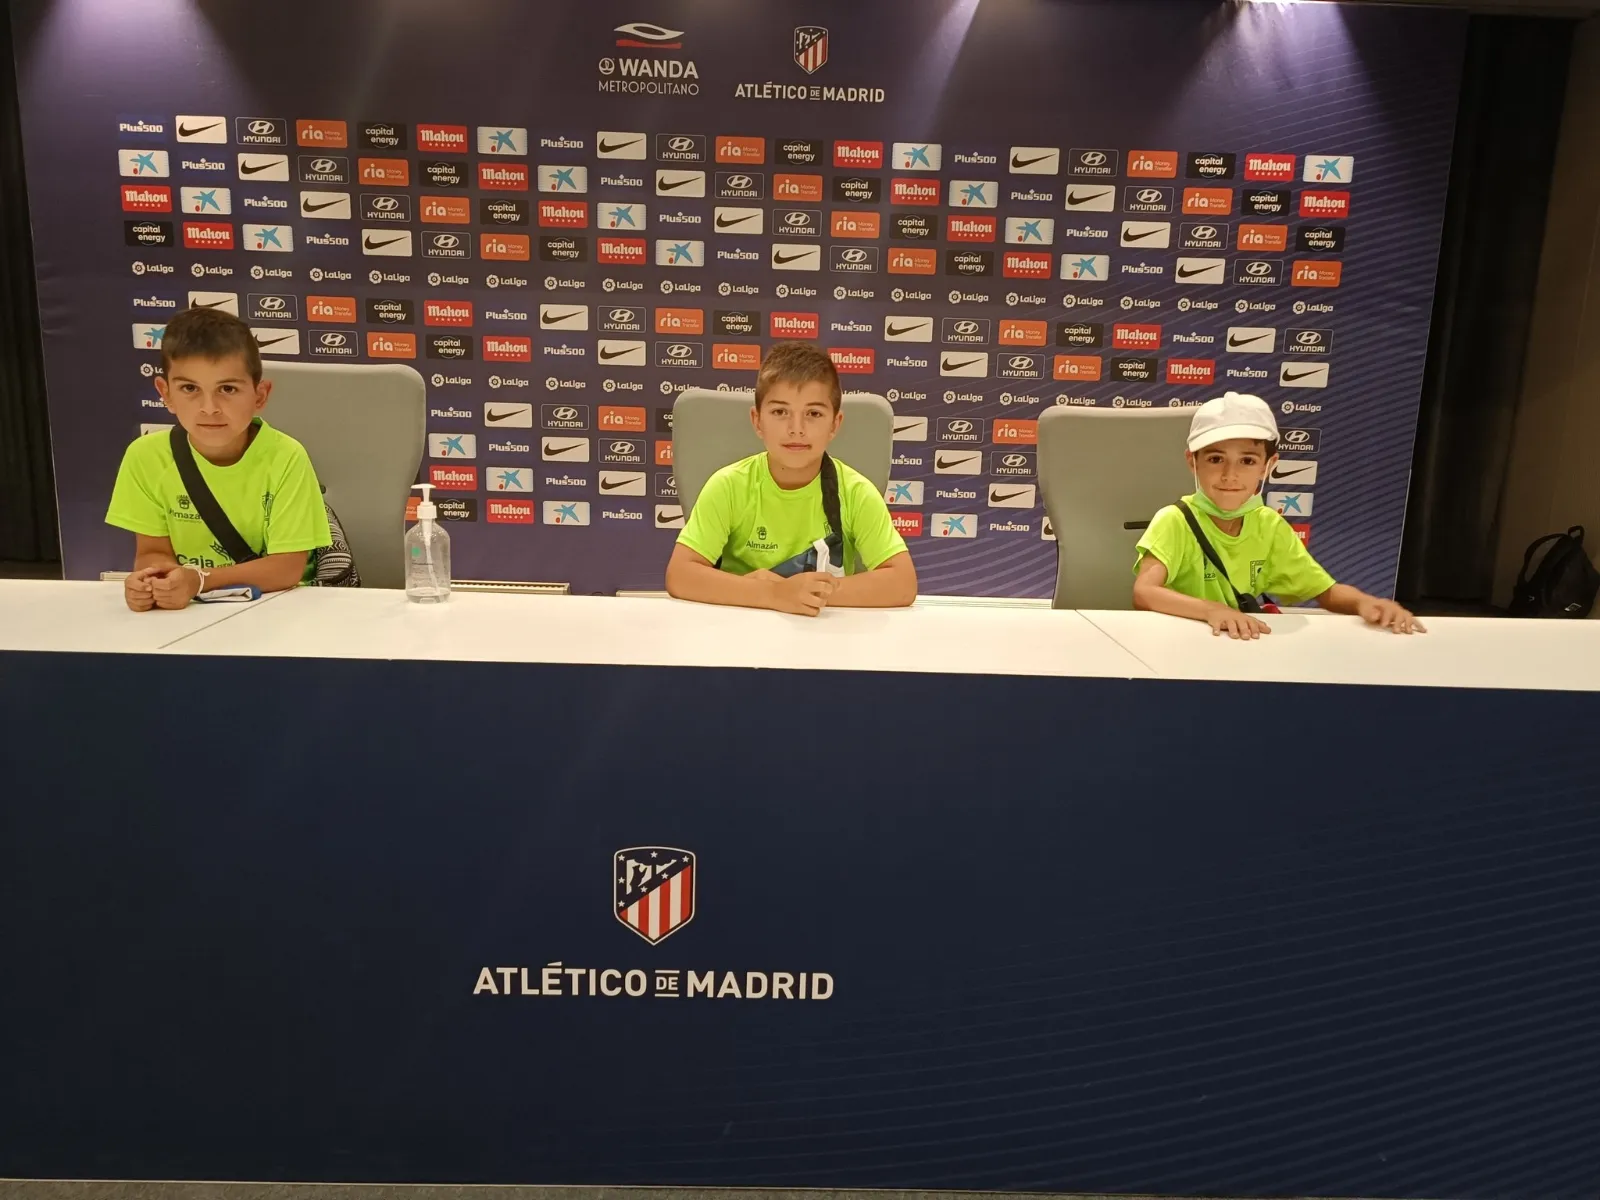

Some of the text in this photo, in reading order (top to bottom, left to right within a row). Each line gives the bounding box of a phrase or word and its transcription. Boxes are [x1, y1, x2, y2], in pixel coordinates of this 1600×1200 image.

[619, 58, 699, 79] WANDA
[598, 80, 699, 96] METROPOLITANO
[735, 81, 807, 100] ATLÉTICO
[823, 87, 885, 103] MADRID
[120, 121, 163, 132] Plus500
[366, 128, 393, 136] capital
[302, 125, 323, 140] ria
[421, 130, 463, 142] Mahou
[371, 137, 398, 145] energy
[541, 136, 583, 148] Plus500
[721, 142, 741, 156] ria
[783, 144, 810, 152] capital
[838, 146, 879, 158] Mahou
[955, 152, 996, 163] Plus500
[1133, 156, 1153, 170] ria
[1195, 157, 1223, 166] capital
[182, 158, 225, 170] Plus500
[1249, 159, 1290, 171] Mahou
[364, 164, 385, 178] ria
[427, 166, 455, 174] capital
[482, 168, 524, 180] Mahou
[1199, 167, 1226, 175] energy
[779, 179, 799, 193] ria
[125, 191, 168, 202] Mahou
[1011, 189, 1052, 201] Plus500
[1188, 193, 1208, 207] ria
[1250, 195, 1278, 203] capital
[244, 196, 287, 207] Plus500
[1304, 196, 1345, 208] Mahou
[426, 202, 446, 216] ria
[488, 204, 515, 212] capital
[542, 206, 584, 218] Mahou
[493, 213, 520, 221] energy
[660, 212, 701, 223] Plus500
[836, 217, 856, 230] ria
[898, 219, 925, 227] capital
[951, 221, 992, 232] Mahou
[133, 226, 160, 234] capital
[187, 228, 230, 239] Mahou
[902, 224, 929, 235] energy
[1067, 226, 1108, 237] Plus500
[1305, 231, 1332, 239] capital
[306, 234, 348, 245] Plus500
[1243, 230, 1263, 243] ria
[486, 239, 506, 253] ria
[548, 241, 574, 249] capital
[1309, 240, 1335, 248] energy
[553, 250, 579, 258] energy
[718, 248, 759, 259] Plus500
[893, 253, 913, 267] ria
[1007, 257, 1047, 269] Mahou
[147, 264, 173, 273] LaLiga
[1122, 262, 1163, 273] Plus500
[1297, 266, 1317, 279] ria
[265, 269, 292, 278] LaLiga
[384, 273, 410, 282] LaLiga
[501, 278, 527, 287] LaLiga
[617, 281, 643, 290] LaLiga
[733, 285, 758, 294] LaLiga
[848, 289, 874, 298] LaLiga
[963, 293, 988, 302] LaLiga
[1078, 297, 1103, 306] LaLiga
[312, 303, 333, 315] ria
[374, 304, 401, 312] capital
[1192, 301, 1218, 310] LaLiga
[1307, 304, 1333, 313] LaLiga
[428, 306, 469, 317] Mahou
[486, 309, 527, 320] Plus500
[661, 313, 680, 327] ria
[722, 315, 748, 323] capital
[774, 317, 814, 328] Mahou
[831, 321, 872, 331] Plus500
[1065, 327, 1091, 335] capital
[1004, 326, 1023, 338] ria
[1117, 329, 1156, 340] Mahou
[1173, 332, 1214, 343] Plus500
[372, 339, 393, 352] ria
[434, 339, 460, 347] capital
[487, 341, 527, 352] Mahou
[544, 344, 585, 355] Plus500
[718, 349, 737, 362] ria
[887, 356, 927, 367] Plus500
[1059, 360, 1078, 373] ria
[1119, 362, 1145, 370] capital
[1123, 369, 1149, 378] energy
[1171, 364, 1210, 375] Mahou
[1227, 367, 1267, 377] Plus500
[446, 377, 471, 385] LaLiga
[560, 380, 585, 389] LaLiga
[901, 392, 926, 400] LaLiga
[1014, 395, 1039, 404] LaLiga
[1296, 404, 1321, 412] LaLiga
[604, 411, 623, 424] ria
[998, 424, 1017, 437] ria
[489, 441, 529, 452] Plus500
[433, 470, 473, 481] Mahou
[546, 475, 586, 486] Plus500
[936, 488, 976, 498] Plus500
[439, 502, 465, 510] capital
[490, 504, 530, 514] Mahou
[603, 509, 642, 519] Plus500
[990, 521, 1029, 531] Plus500
[746, 541, 778, 550] Almazán
[177, 554, 214, 568] Caja
[473, 961, 834, 1000] ATLÉTICO DE MADRID
